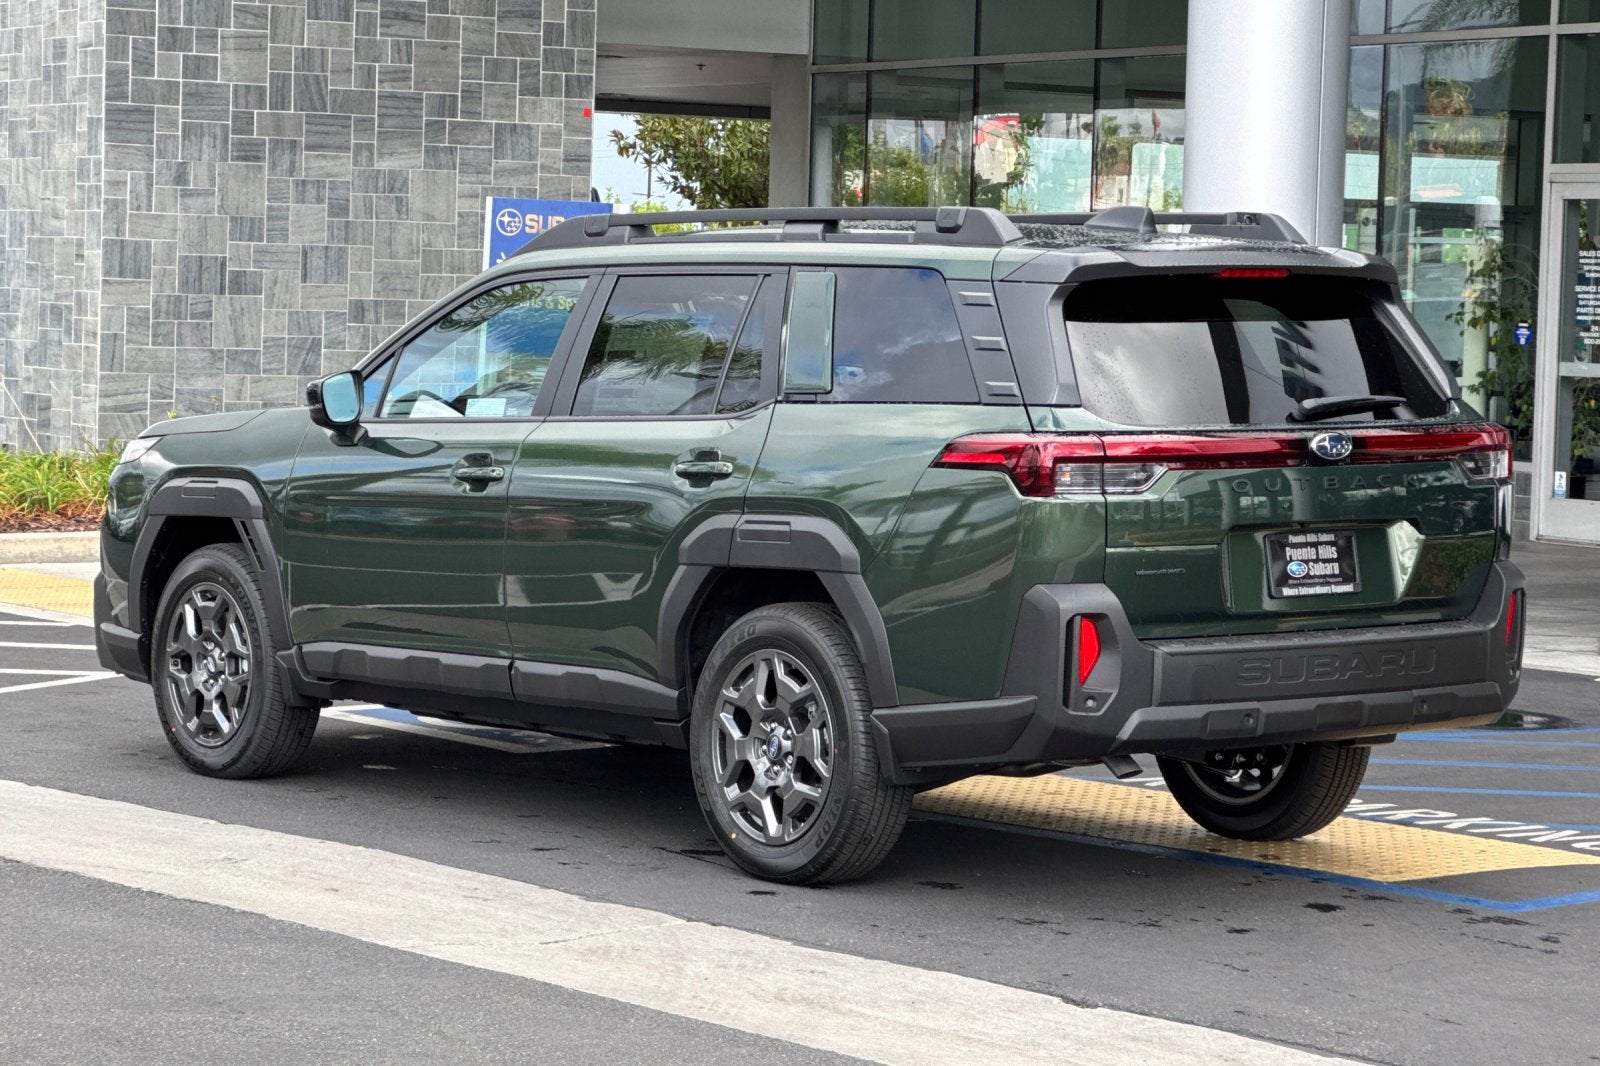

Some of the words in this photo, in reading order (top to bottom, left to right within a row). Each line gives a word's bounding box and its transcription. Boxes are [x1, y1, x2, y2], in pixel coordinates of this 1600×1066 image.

[1232, 474, 1419, 493] OUTBACK
[1285, 546, 1316, 560] Puente
[1318, 545, 1338, 559] Hills
[1308, 562, 1340, 576] Subaru
[1237, 648, 1437, 686] SUBARU
